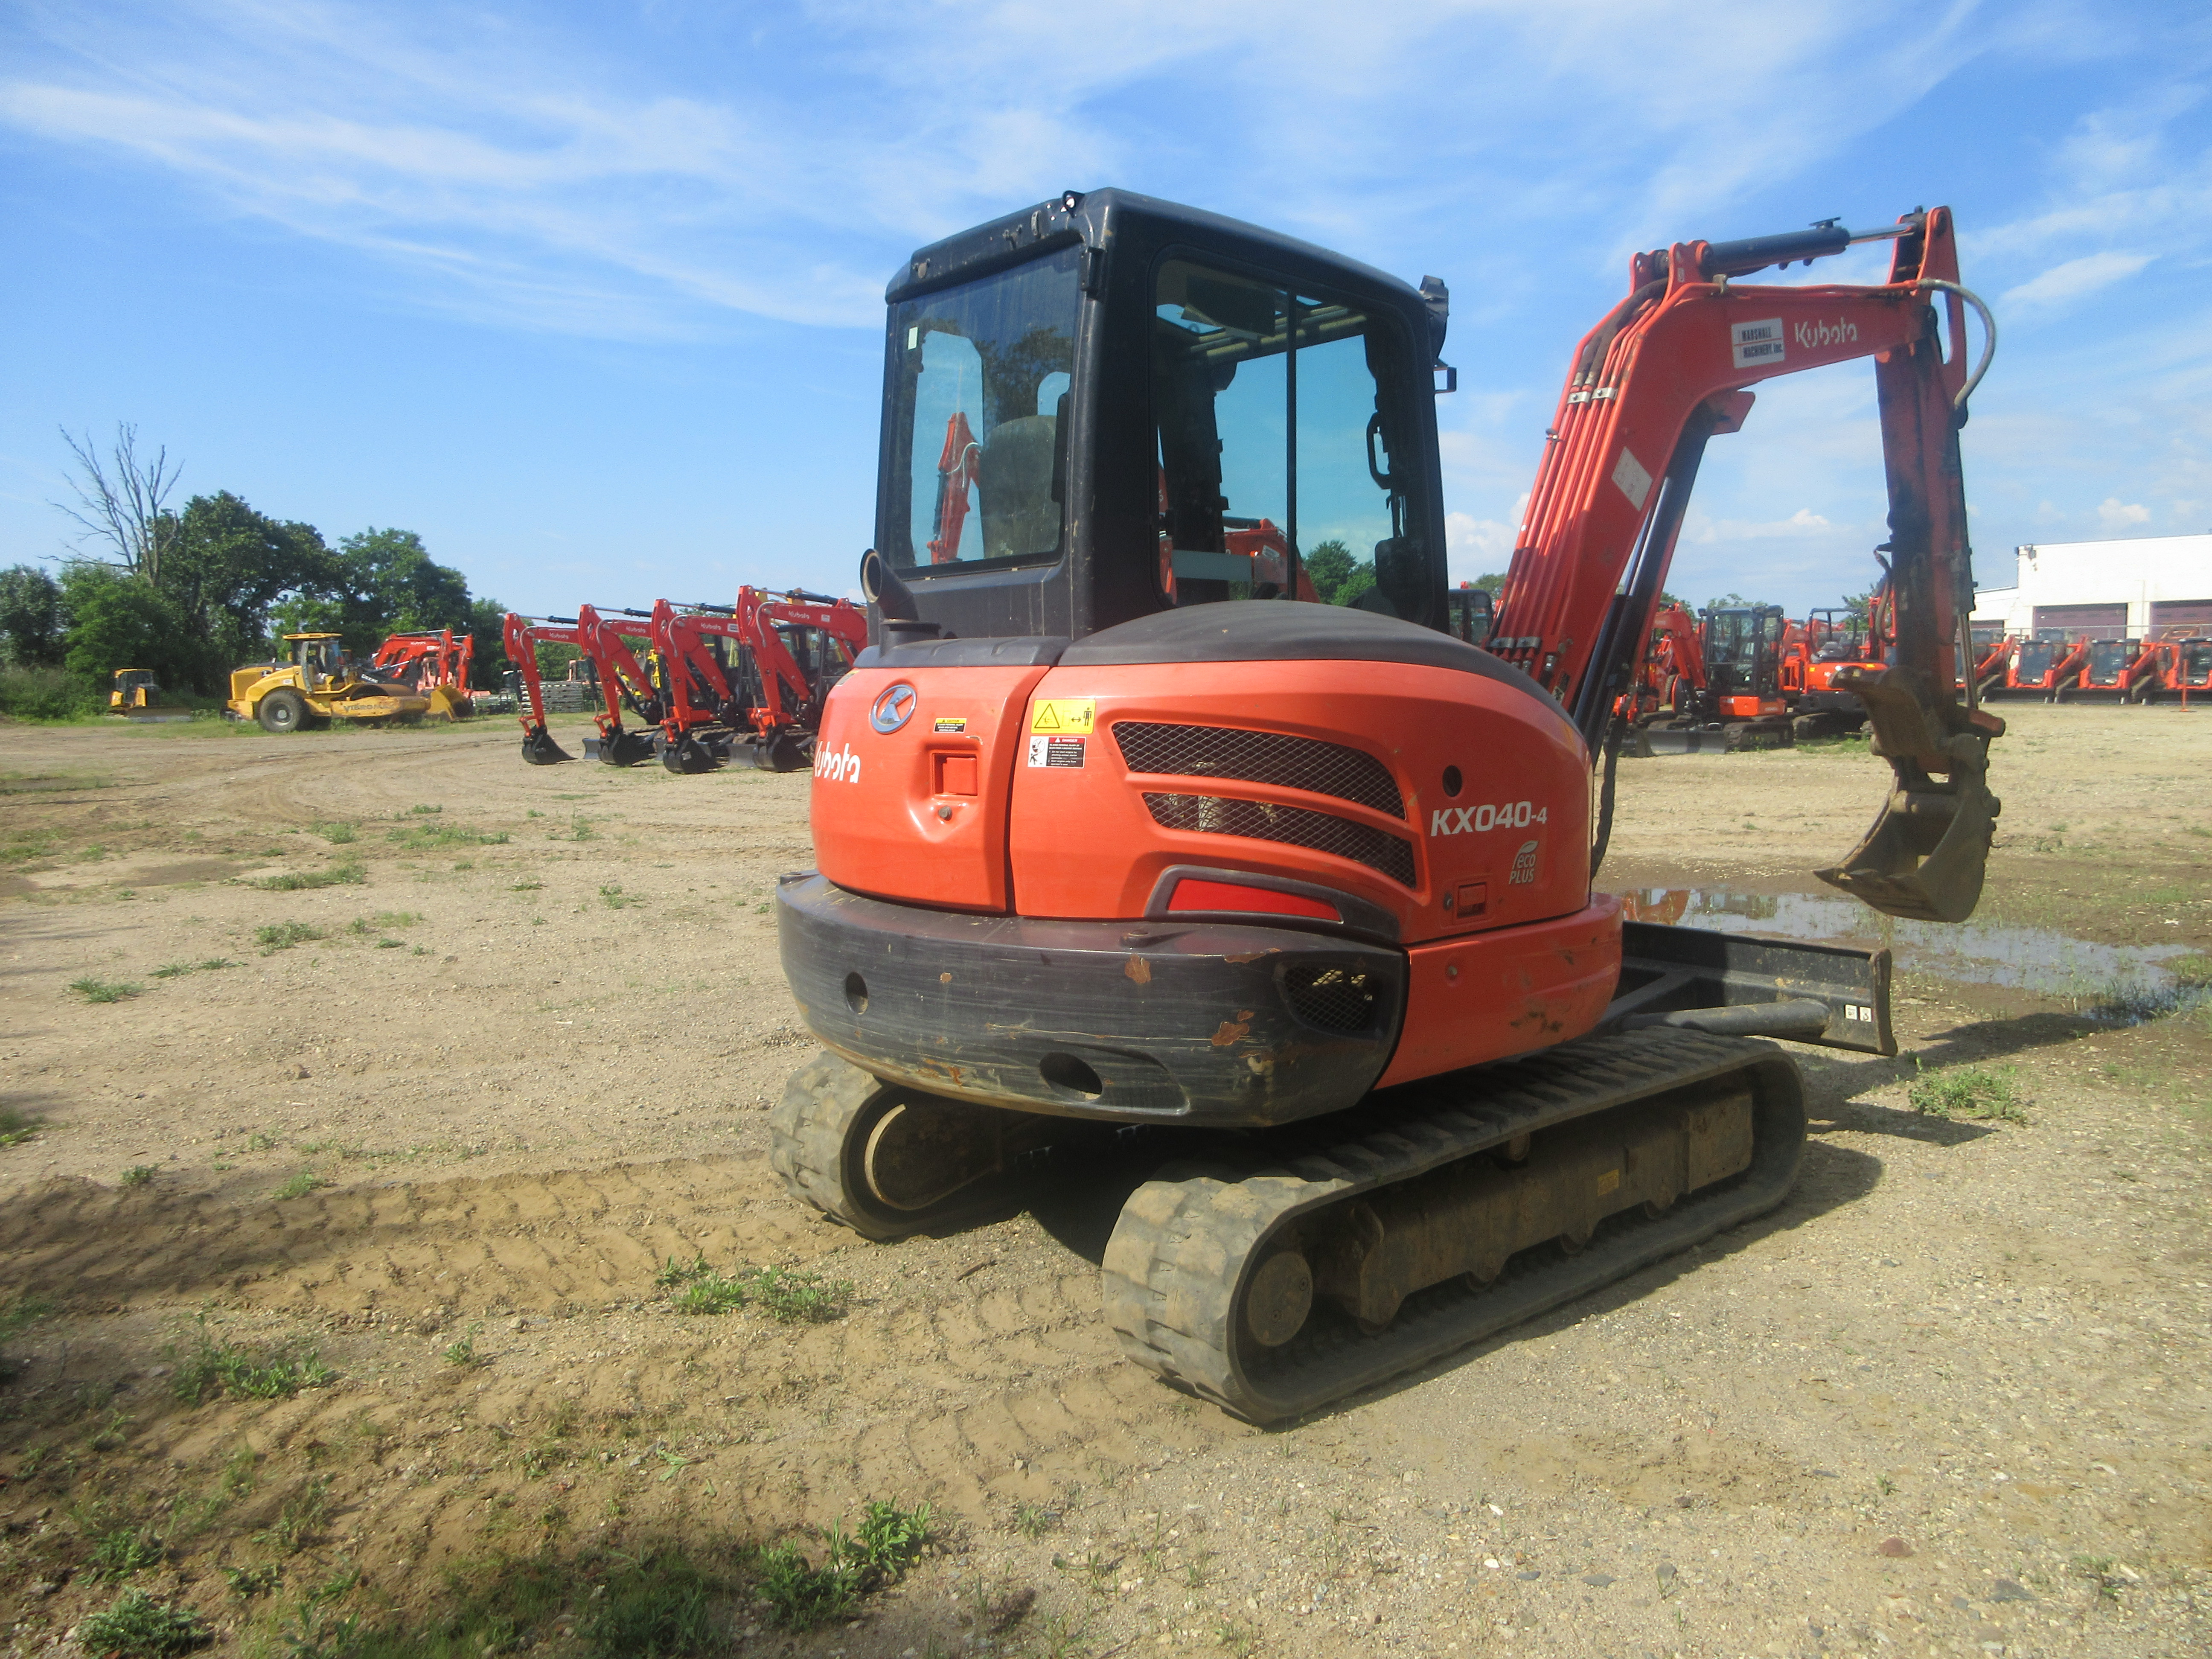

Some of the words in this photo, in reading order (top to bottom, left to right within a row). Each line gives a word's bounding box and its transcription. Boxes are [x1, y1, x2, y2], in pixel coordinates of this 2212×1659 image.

[1741, 327, 1772, 341] MARSHALL
[1795, 316, 1858, 348] Kubota
[1431, 800, 1547, 837] KX040-4
[1516, 854, 1536, 869] eco
[1508, 868, 1535, 885] PLUS
